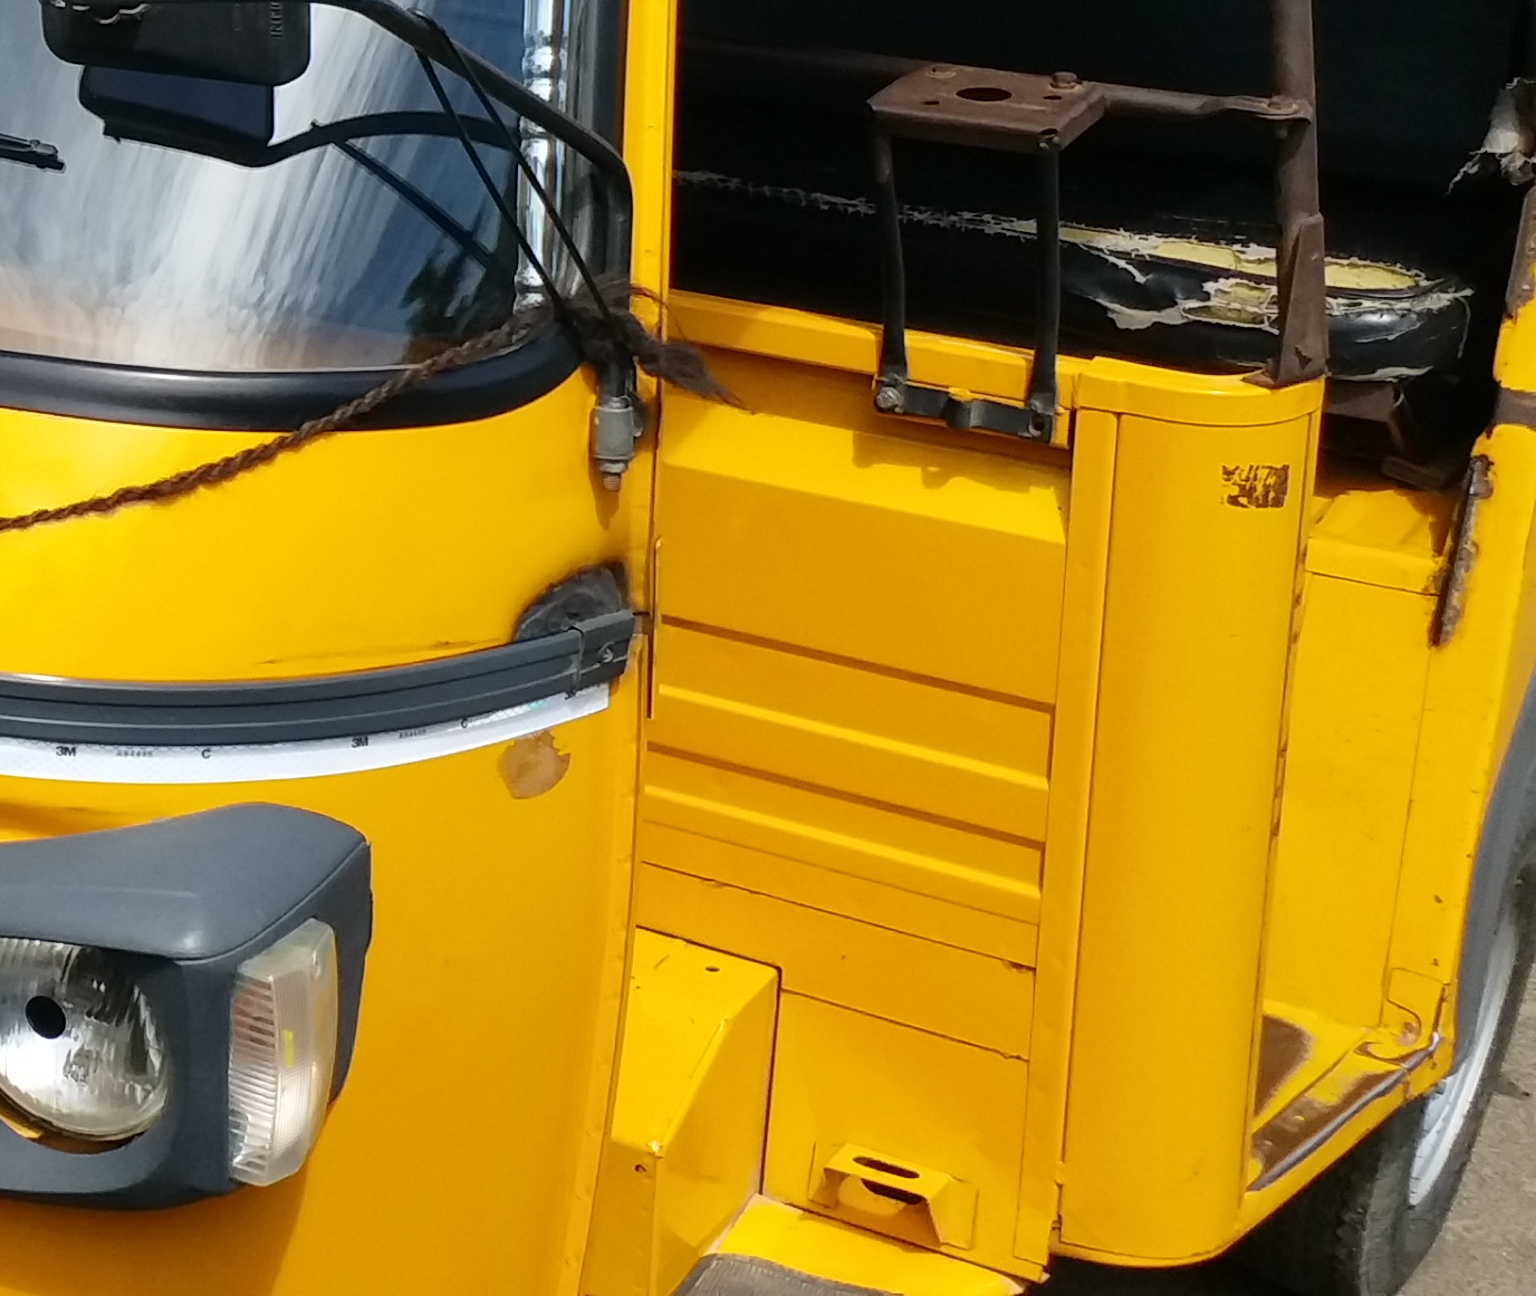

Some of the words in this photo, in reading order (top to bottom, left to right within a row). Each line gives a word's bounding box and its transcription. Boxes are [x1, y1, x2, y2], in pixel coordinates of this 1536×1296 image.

[351, 736, 369, 749] 3M
[55, 745, 77, 757] 3M
[201, 748, 212, 759] C
